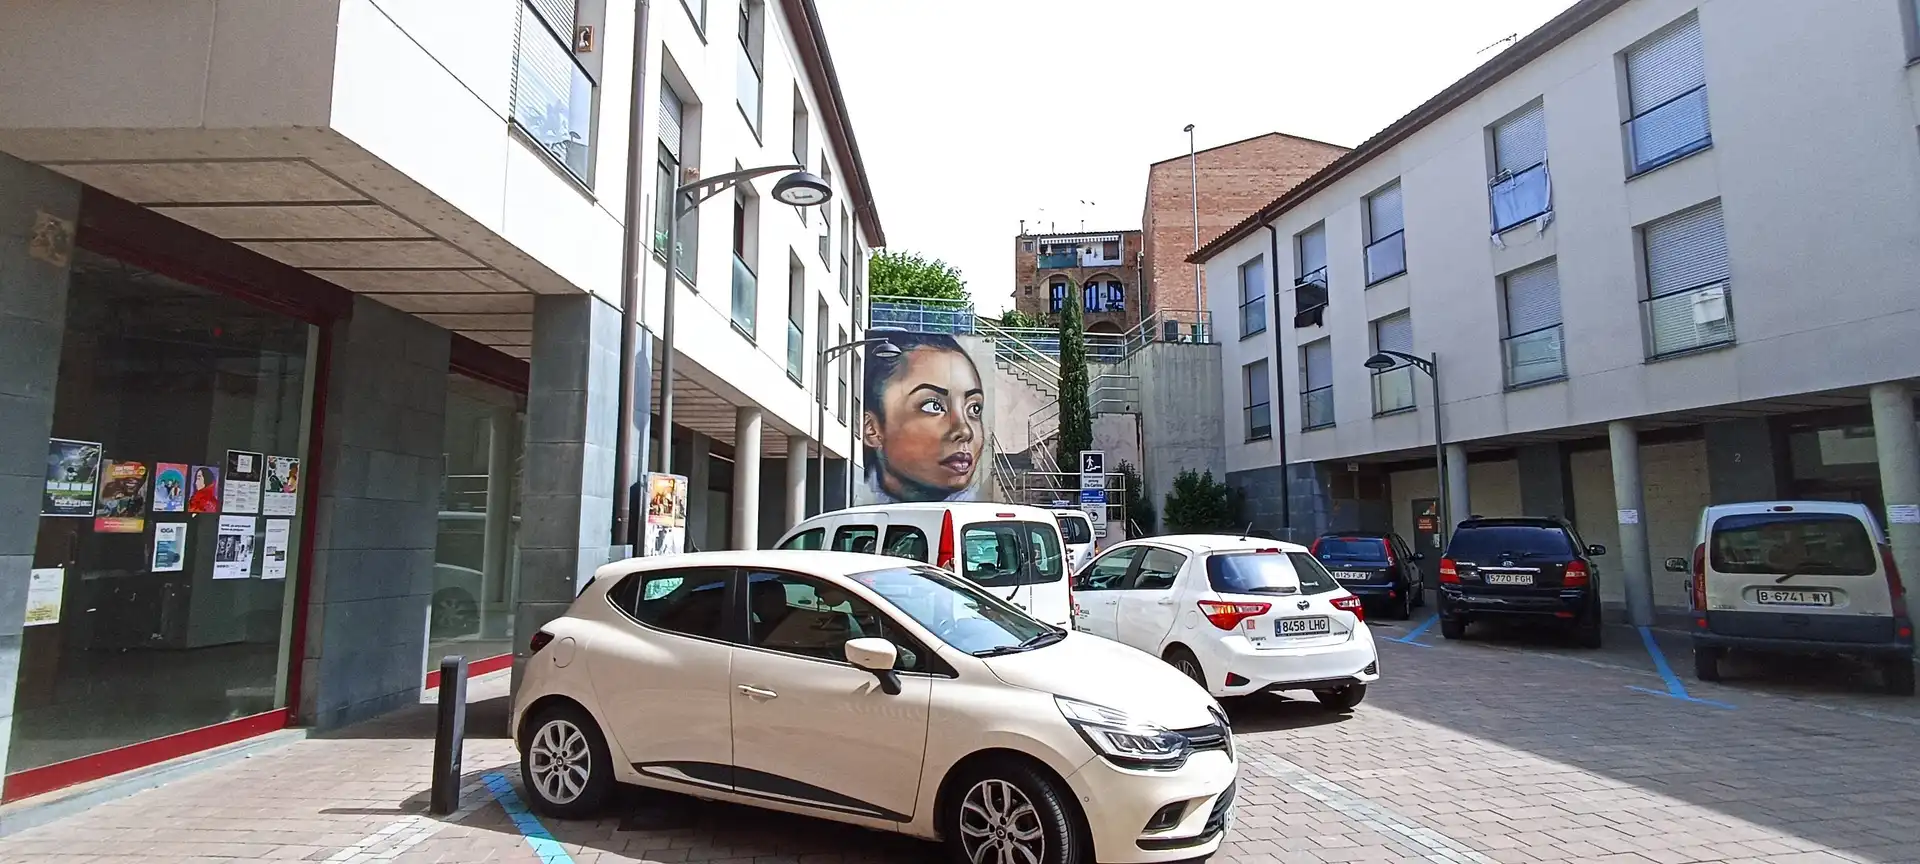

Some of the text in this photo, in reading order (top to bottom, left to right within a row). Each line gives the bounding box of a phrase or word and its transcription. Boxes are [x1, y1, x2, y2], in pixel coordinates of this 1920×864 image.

[1734, 453, 1741, 463] 2
[1515, 575, 1531, 583] FGH
[1282, 619, 1326, 632] 8458 LHG
